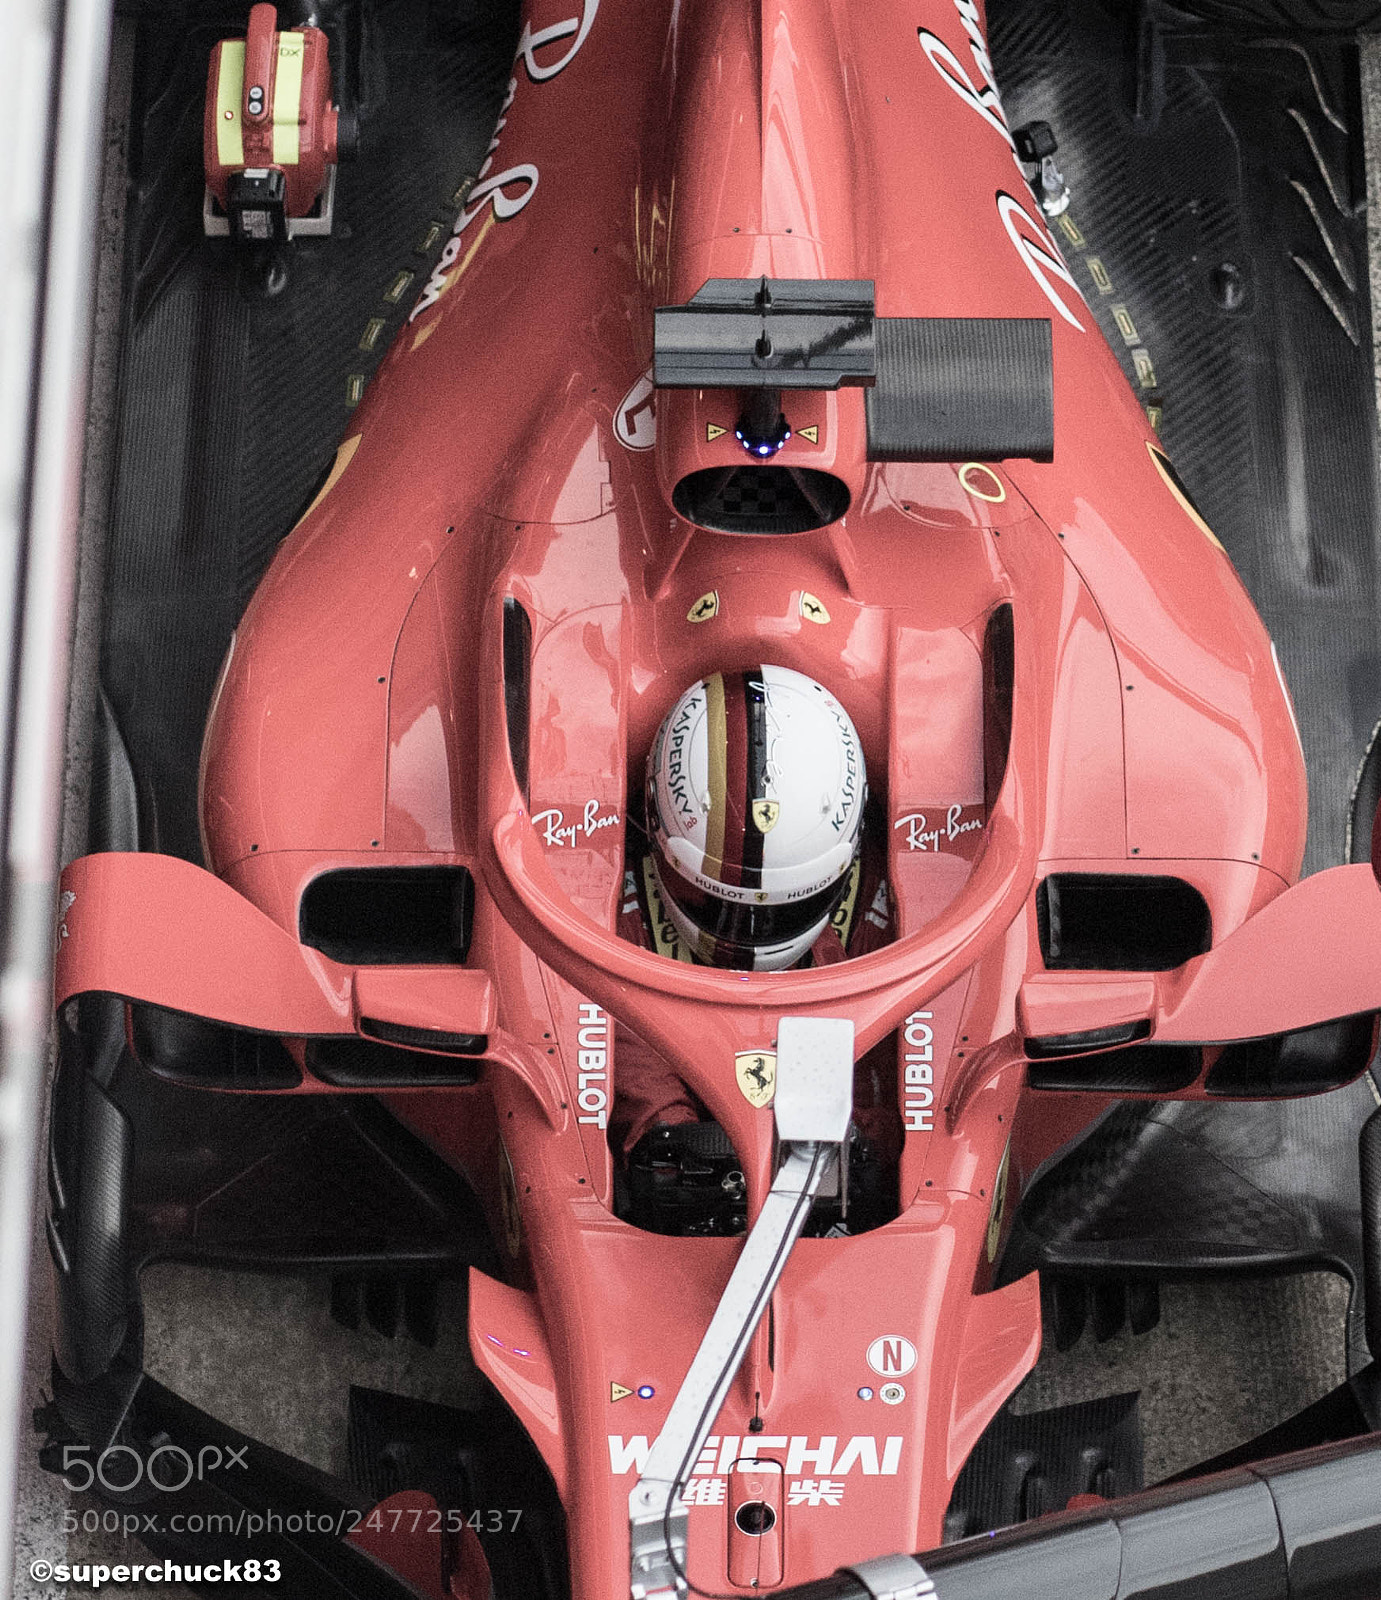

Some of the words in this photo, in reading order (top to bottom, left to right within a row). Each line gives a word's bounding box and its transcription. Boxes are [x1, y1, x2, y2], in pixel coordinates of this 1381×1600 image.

[667, 697, 702, 814] KASPERSKY
[830, 709, 856, 833] KASPERSKY
[695, 876, 746, 900] HUBLOT
[787, 876, 833, 900] HUBLOT
[577, 1003, 608, 1130] HUBLOT
[882, 1340, 902, 1372] N
